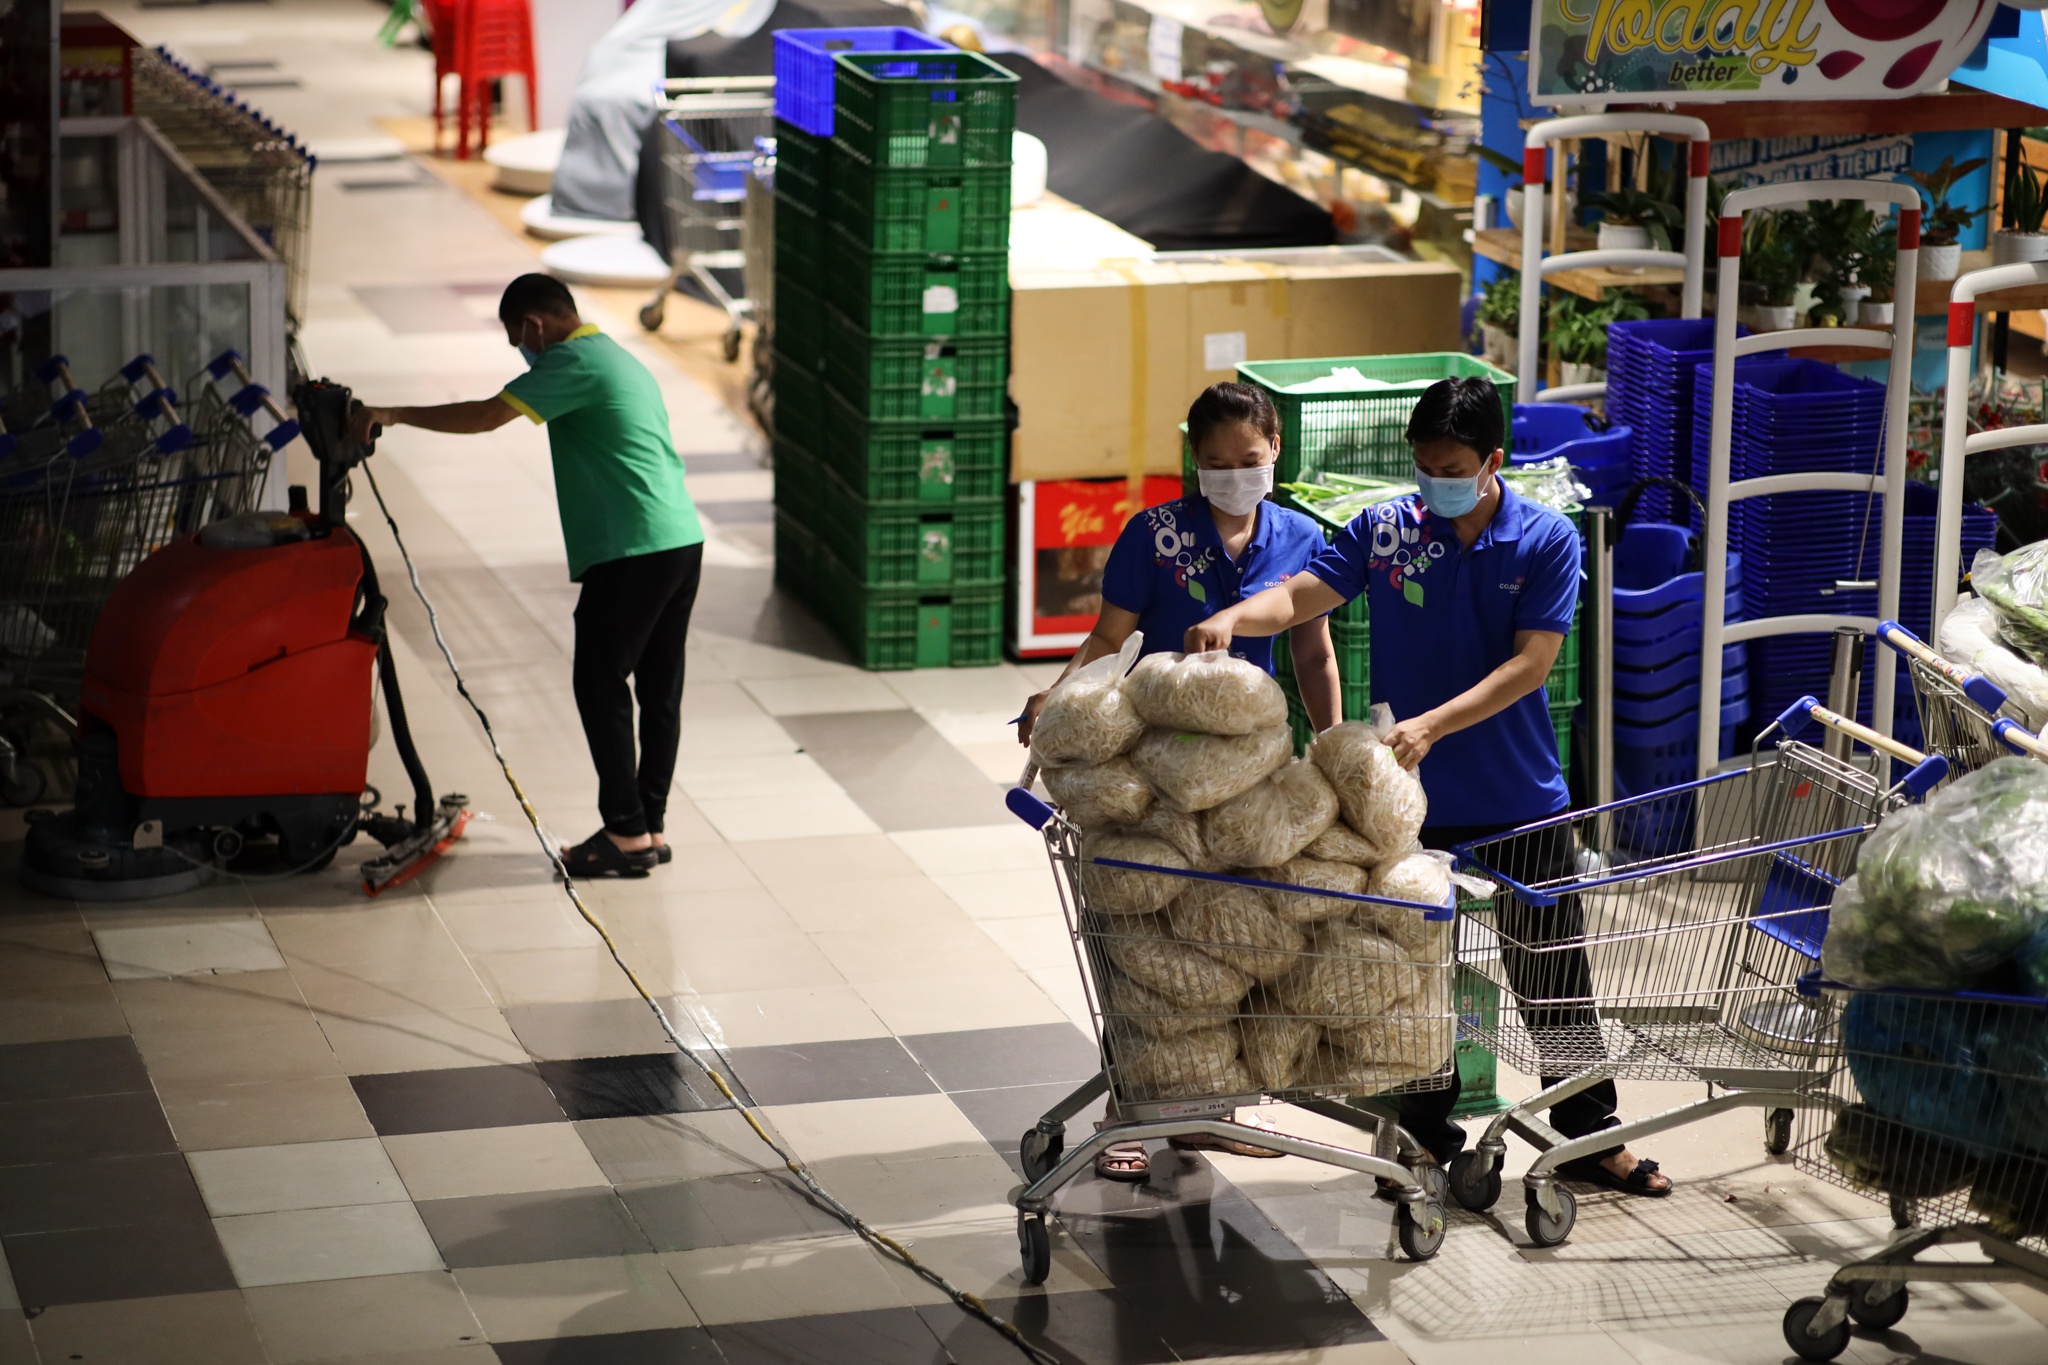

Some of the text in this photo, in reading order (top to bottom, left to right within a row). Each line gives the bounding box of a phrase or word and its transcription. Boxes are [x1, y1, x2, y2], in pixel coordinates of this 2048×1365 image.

[1559, 0, 1821, 75] Today
[1668, 61, 1739, 83] better
[1207, 1103, 1225, 1111] 2515
